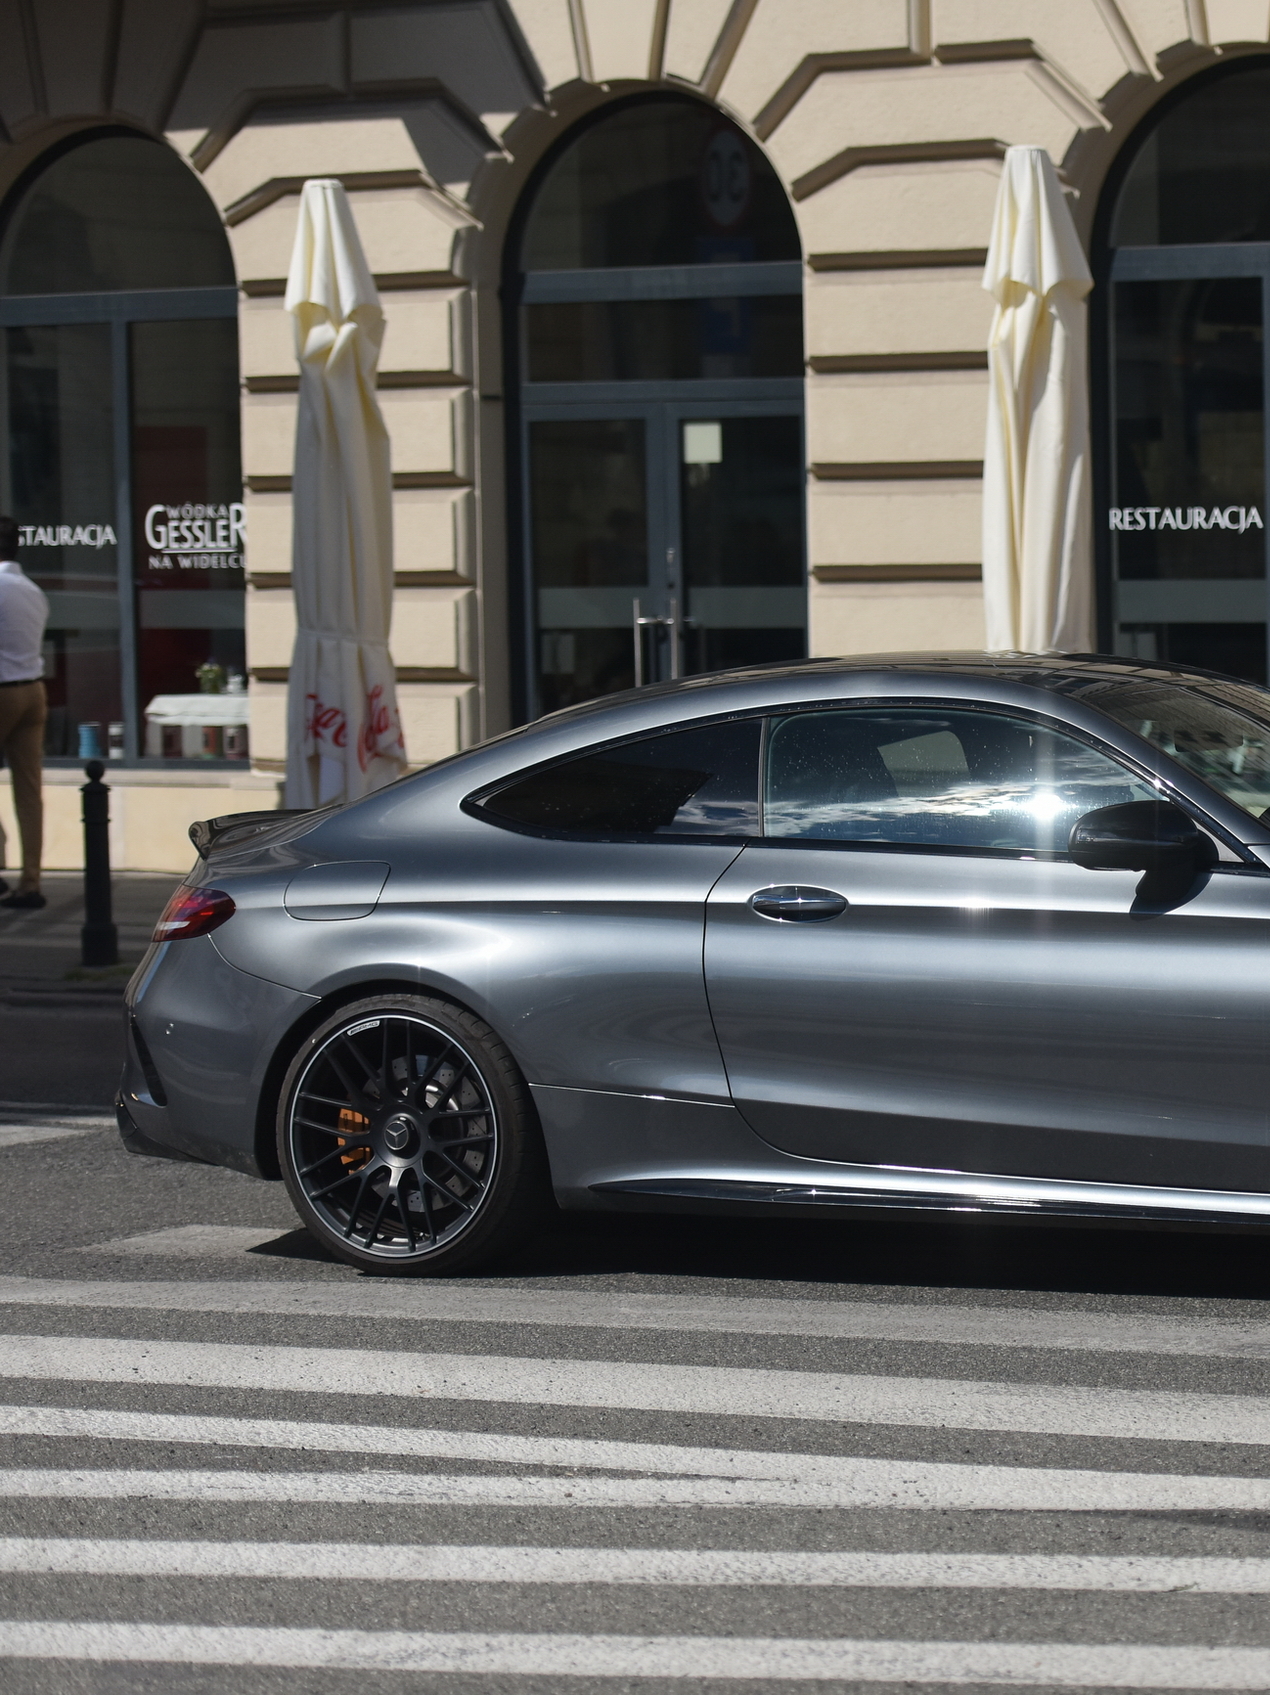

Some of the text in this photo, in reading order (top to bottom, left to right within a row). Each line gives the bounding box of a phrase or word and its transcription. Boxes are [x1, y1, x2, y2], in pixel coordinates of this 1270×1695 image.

[165, 501, 229, 519] WÓDKA
[1108, 505, 1264, 535] RESTAURACJA
[144, 502, 247, 550] GESSLER
[149, 554, 174, 570] NA
